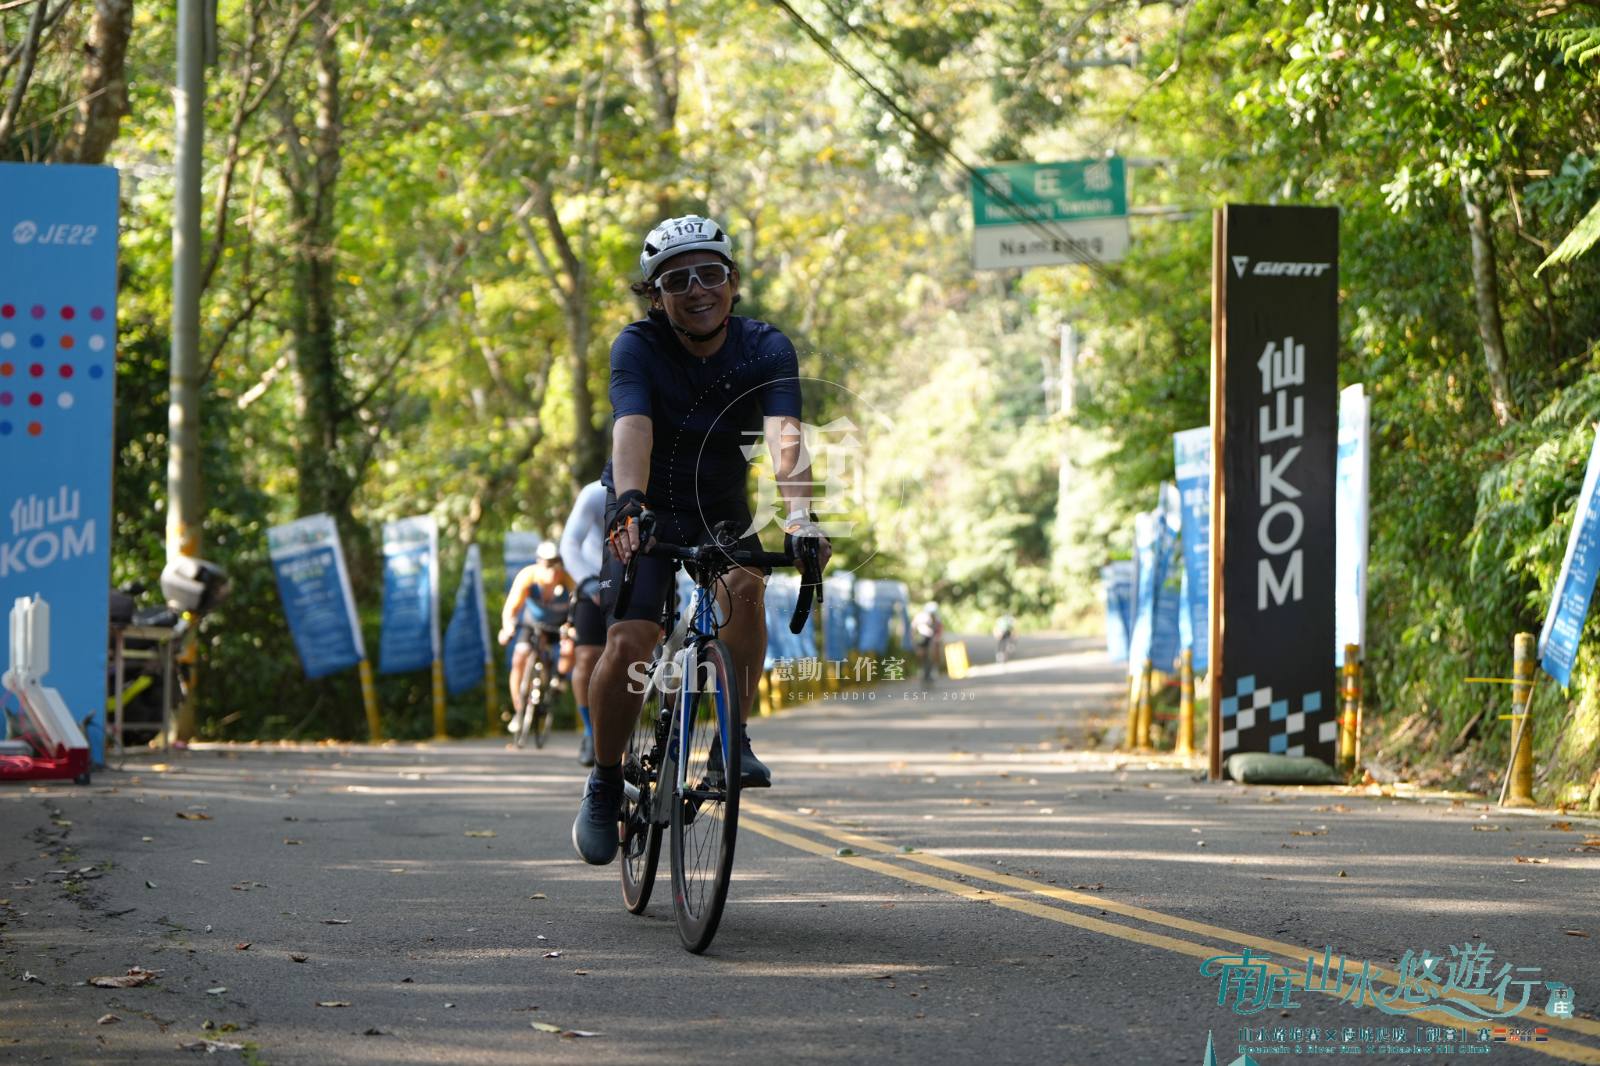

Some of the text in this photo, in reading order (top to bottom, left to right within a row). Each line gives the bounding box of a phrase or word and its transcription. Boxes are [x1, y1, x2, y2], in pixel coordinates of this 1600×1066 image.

[37, 223, 98, 246] JE22
[1252, 261, 1330, 277] GIANT
[9, 485, 80, 536] 仙山
[0, 518, 96, 578] KOM
